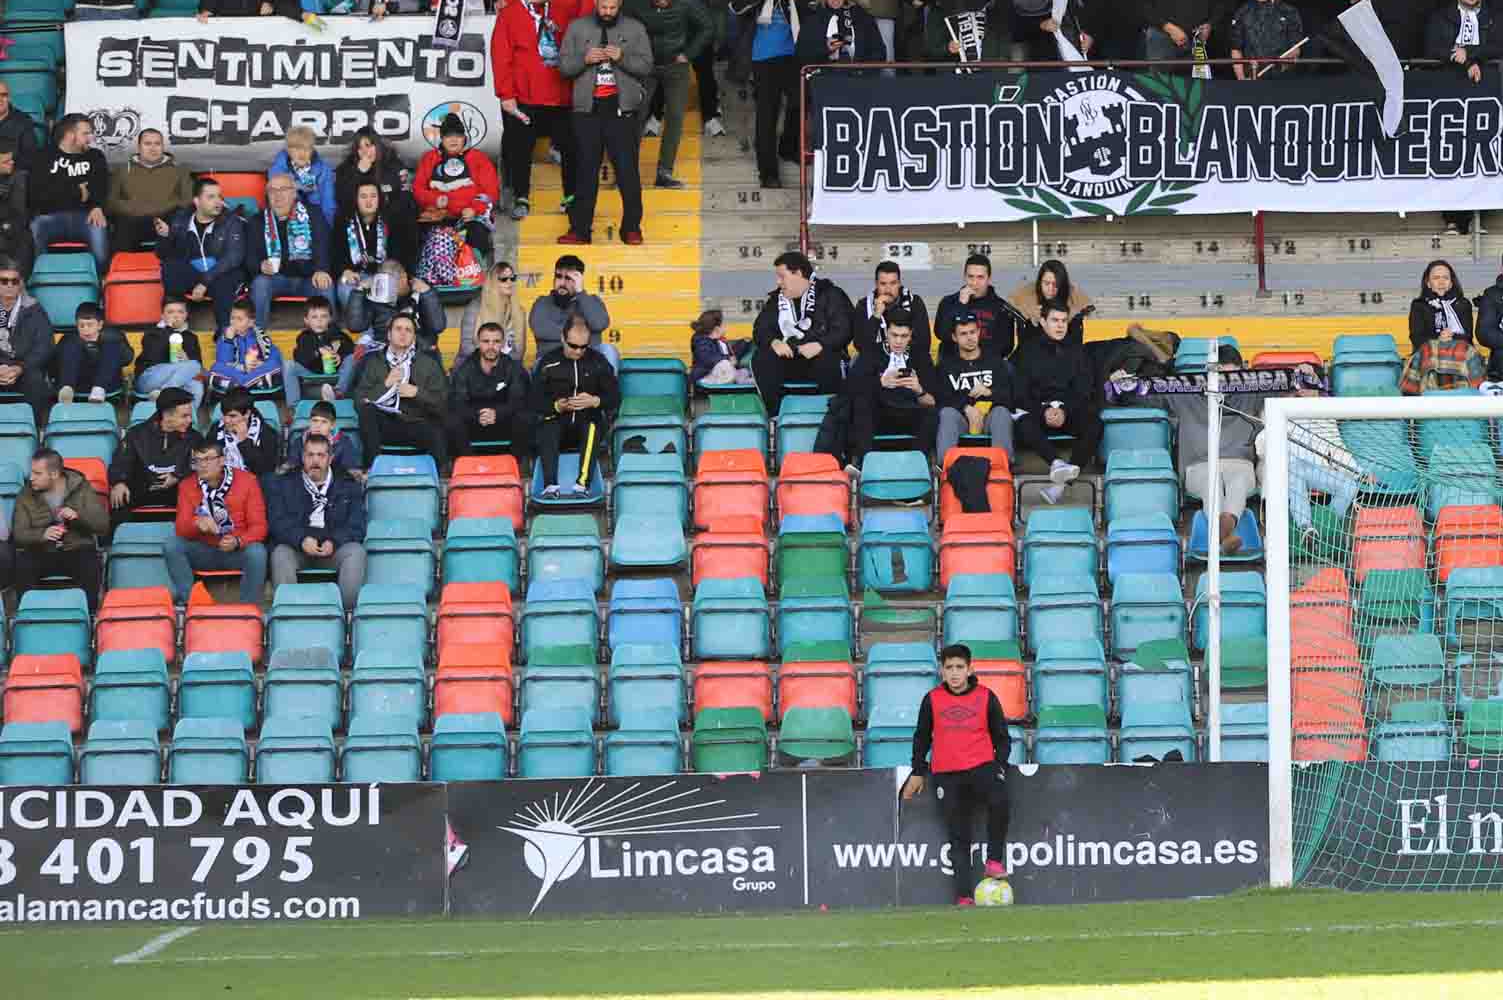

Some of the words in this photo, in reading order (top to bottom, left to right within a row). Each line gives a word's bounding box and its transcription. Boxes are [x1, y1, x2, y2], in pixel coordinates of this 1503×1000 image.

[98, 40, 486, 81] SENTIMIENTO
[171, 104, 411, 140] CHARRO
[821, 84, 1064, 190] BASTIÓN
[50, 157, 92, 177] JUMP
[947, 370, 993, 392] VANS
[223, 782, 382, 828] AQUÍ
[1397, 793, 1450, 856] El
[39, 836, 155, 884] 401
[190, 836, 315, 882] 795
[588, 836, 777, 880] Limcasa
[733, 877, 777, 894] Grupo
